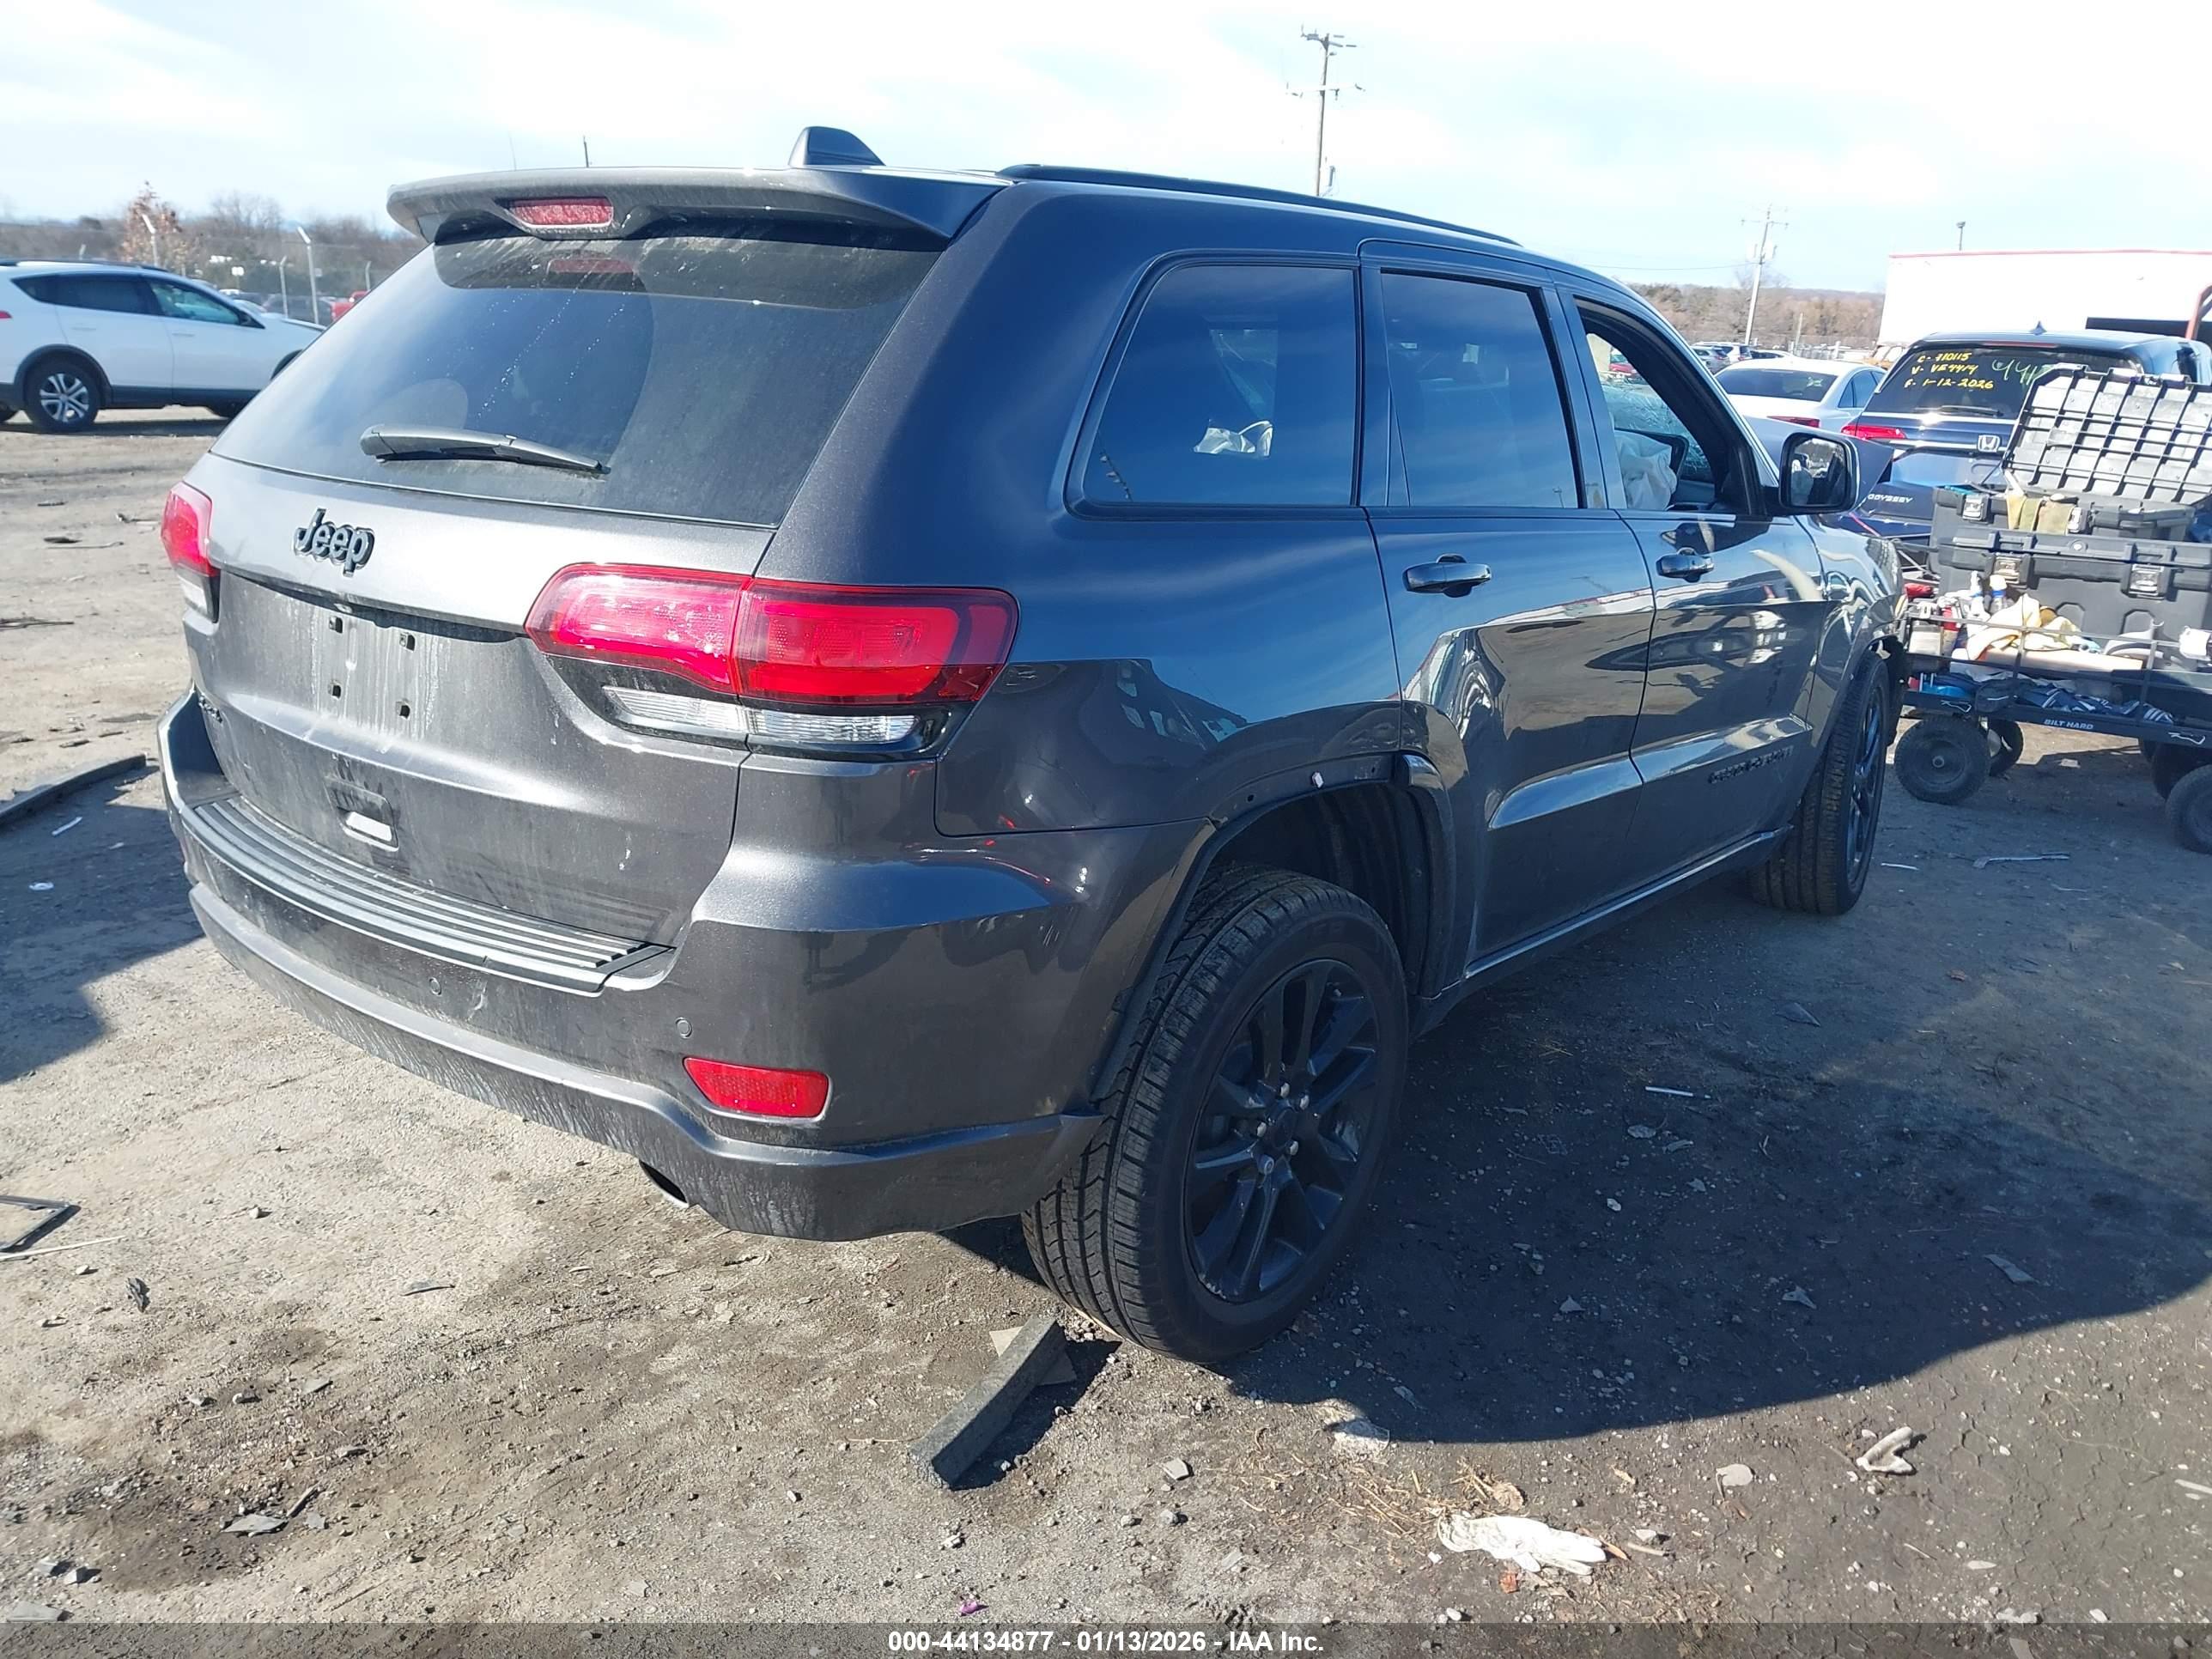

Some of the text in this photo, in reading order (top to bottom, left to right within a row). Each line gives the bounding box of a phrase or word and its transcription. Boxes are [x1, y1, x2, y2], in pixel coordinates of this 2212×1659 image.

[1868, 493, 1913, 503] ODYSSEY
[294, 507, 375, 578] Jeep
[2066, 721, 2094, 730] HARD
